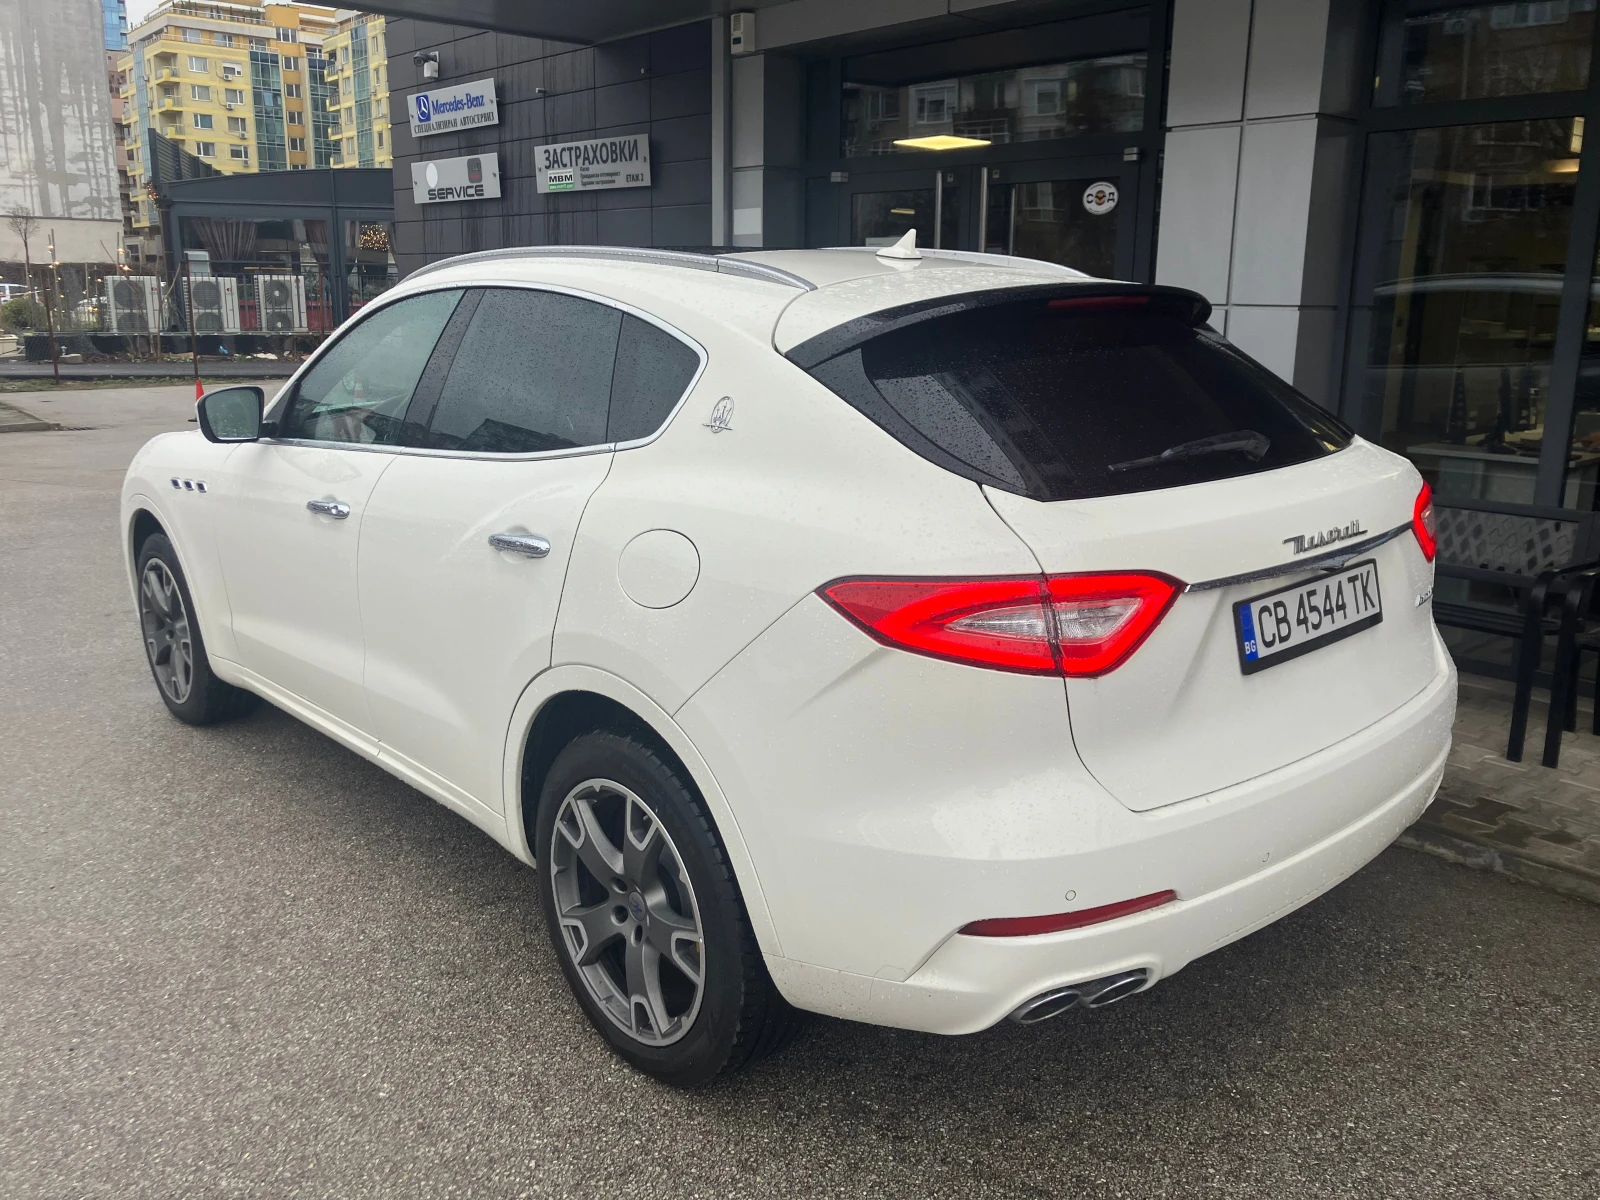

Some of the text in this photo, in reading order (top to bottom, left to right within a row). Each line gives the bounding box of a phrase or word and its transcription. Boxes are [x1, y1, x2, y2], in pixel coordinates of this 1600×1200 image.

[431, 93, 485, 115] Mercedes-Benz
[413, 111, 495, 134] СПЕЦИАЛИЗИРАН АВТОСЕРВИЗ
[543, 139, 639, 170] ЗАСТРАХОВКИ
[626, 173, 640, 183] ЕТАЖ
[640, 173, 645, 182] 2
[427, 184, 485, 201] SERVICE
[1282, 519, 1368, 555] Maserati
[1257, 600, 1292, 648] CB
[1296, 580, 1348, 634] 4544
[1347, 570, 1376, 615] TK
[1244, 639, 1257, 655] BG
